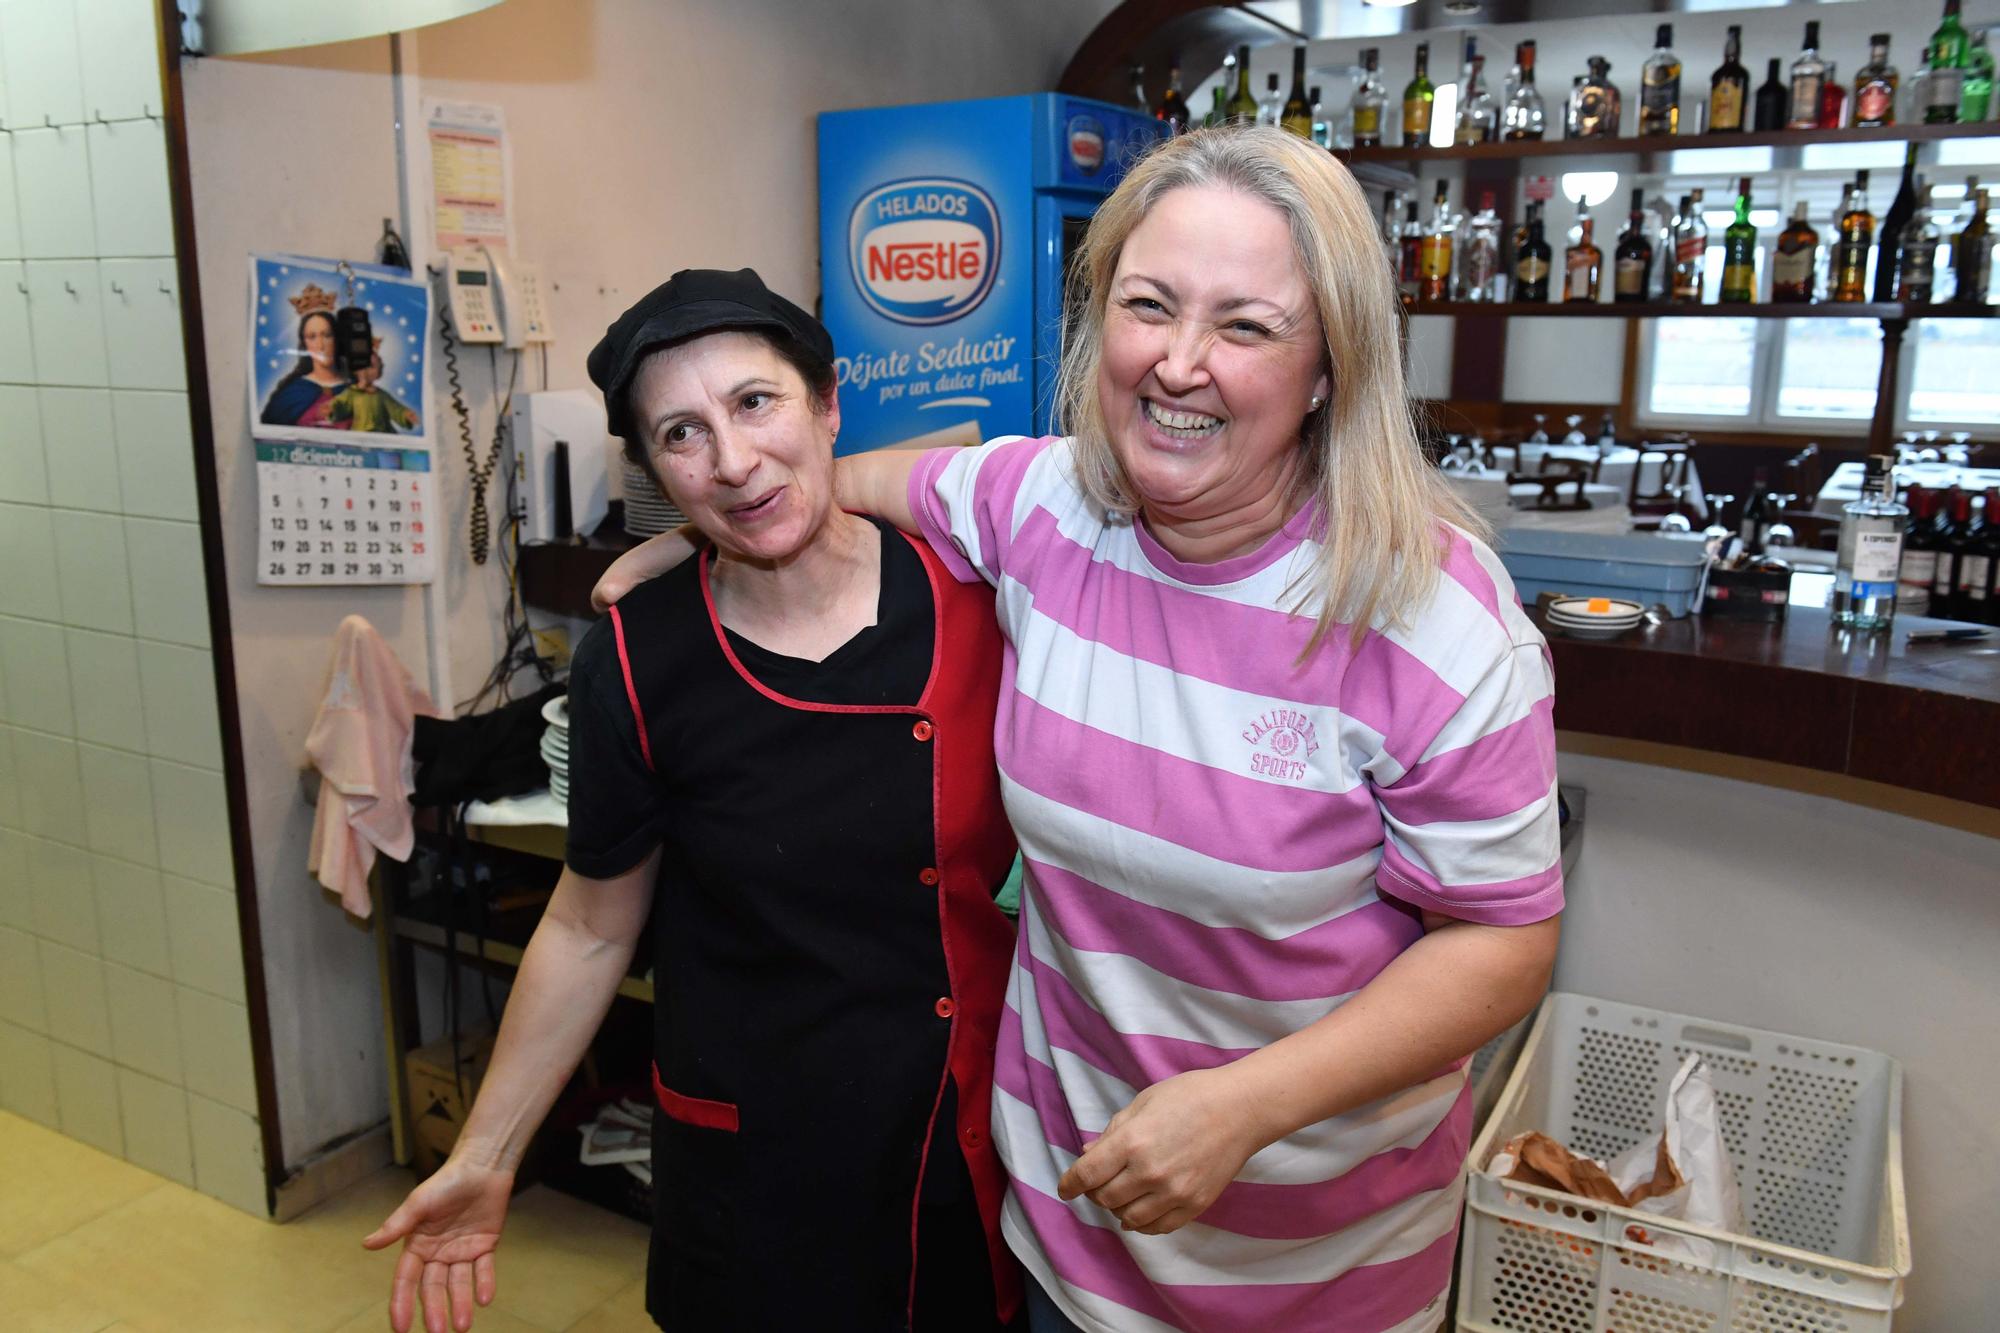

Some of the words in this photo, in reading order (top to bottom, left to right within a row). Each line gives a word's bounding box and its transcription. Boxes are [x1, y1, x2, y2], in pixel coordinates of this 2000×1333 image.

[878, 194, 968, 219] HELADOS
[867, 241, 980, 281] Nestlé
[835, 352, 910, 391] Déjate
[917, 333, 1016, 373] Seducir
[879, 384, 905, 406] por
[909, 381, 931, 396] un
[935, 372, 975, 393] dulce
[978, 363, 1023, 391] final.
[290, 447, 365, 467] diciembre
[345, 477, 352, 488] 1
[369, 478, 375, 490] 2
[391, 479, 398, 491] 3
[273, 495, 280, 507] 5
[321, 498, 328, 509] 7
[368, 500, 375, 509] 9
[389, 501, 400, 512] 10
[272, 518, 284, 530] 12
[295, 519, 308, 530] 13
[320, 520, 332, 531] 14
[344, 520, 356, 532] 15
[368, 521, 379, 532] 16
[390, 522, 401, 532] 17
[272, 541, 285, 552] 19
[296, 541, 309, 553] 20
[320, 542, 332, 553] 21
[345, 542, 356, 553] 22
[367, 543, 380, 554] 23
[390, 543, 402, 554] 24
[412, 543, 425, 554] 25
[270, 563, 285, 575] 26
[296, 564, 311, 575] 27
[321, 564, 334, 575] 28
[345, 564, 358, 575] 29
[368, 564, 382, 575] 30
[392, 564, 403, 575] 31
[1250, 752, 1307, 781] SPORTS
